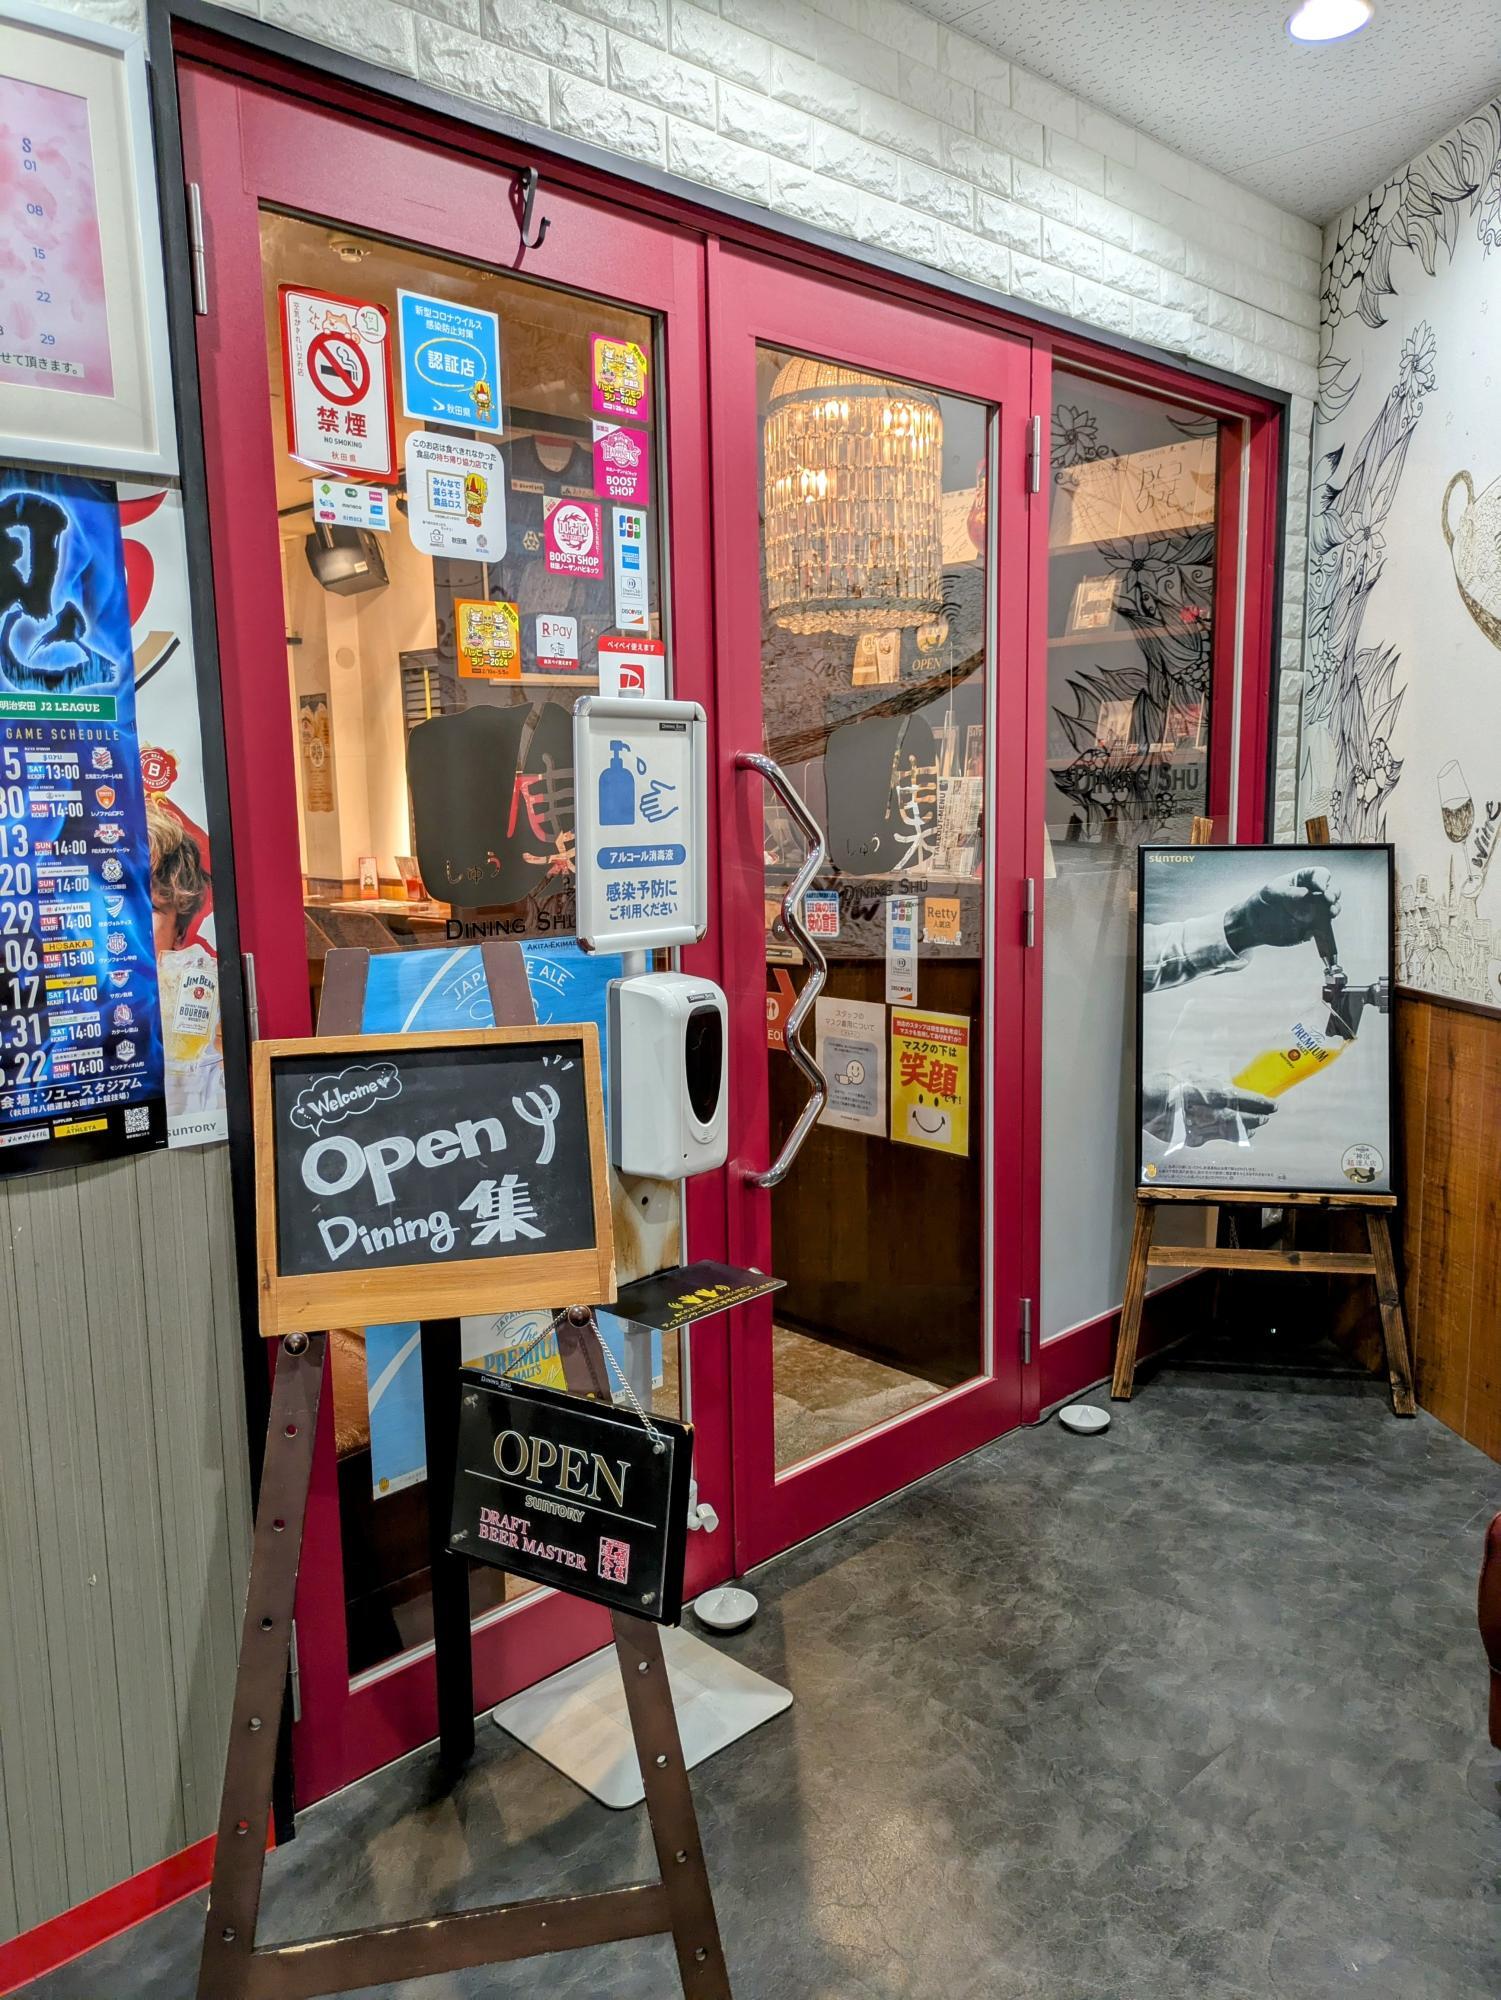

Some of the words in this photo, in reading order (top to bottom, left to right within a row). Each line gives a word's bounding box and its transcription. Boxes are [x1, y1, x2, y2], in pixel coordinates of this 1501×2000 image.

[22, 138, 32, 153] S
[24, 160, 37, 172] 01
[27, 203, 43, 216] 08
[33, 247, 46, 260] 15
[36, 291, 51, 303] 22
[415, 305, 483, 330] 新型コロナウイルス
[426, 320, 474, 339] 感染防止対策
[40, 333, 56, 345] 29
[427, 350, 475, 377] 認証店
[447, 403, 471, 417] 秋田県
[317, 405, 368, 438] 禁煙
[324, 436, 333, 444] NO
[334, 438, 363, 449] SMOKING
[413, 439, 497, 462] このお店は食べきれなかった
[416, 450, 494, 470] 食品の持ち帰り協力店です
[432, 477, 461, 489] みんなで
[606, 476, 637, 486] BOOST
[433, 487, 461, 499] 減らそう
[609, 487, 634, 496] SHOP
[433, 497, 462, 509] 食品ロス
[549, 552, 576, 564] BOOST
[578, 555, 599, 566] SHOP
[552, 623, 572, 639] Pay
[607, 641, 655, 652] ペイペイ使えます
[471, 657, 508, 667] ラリー2024
[912, 658, 942, 671] OPEN
[0, 701, 36, 711] 明治安田
[40, 702, 52, 711] J2
[55, 702, 100, 712] LEAGUE
[6, 728, 43, 739] GAME
[51, 728, 120, 741] SCHEDULE
[47, 764, 79, 780] 13:00
[148, 762, 160, 776] B
[50, 802, 83, 817] 14:00
[54, 840, 87, 855] 14:00
[610, 849, 674, 864] アルコール消毒液
[1148, 854, 1196, 864] SUNTORY
[57, 878, 89, 893] 14:00
[606, 879, 678, 902] 感染予防に
[609, 902, 678, 920] ご利用ください
[927, 906, 957, 922] Retty
[60, 914, 91, 930] 14:00
[446, 918, 526, 940] DINING
[62, 951, 95, 967] 15:00
[183, 976, 198, 988] JIM
[199, 974, 215, 991] BEAM
[540, 965, 567, 987] ALE
[65, 987, 97, 1004] 14:00
[179, 1006, 209, 1019] BOURBON
[69, 1023, 101, 1040] 14:00
[902, 1040, 957, 1057] マスクの下は
[1291, 1022, 1329, 1063] PREMIUM
[72, 1059, 103, 1076] 14:00
[900, 1051, 958, 1096] 笑顔
[307, 1081, 379, 1117] Welcome
[66, 1125, 96, 1135] ATHLETA
[301, 1117, 507, 1206] Open
[317, 1210, 460, 1261] Dining
[458, 1174, 546, 1246] 集
[513, 1364, 542, 1381] MALTS
[493, 1429, 631, 1508] OPEN
[525, 1494, 585, 1523] SUNTORY
[480, 1507, 531, 1535] DRAFT
[478, 1523, 519, 1550] BEER
[522, 1536, 588, 1571] MASTER
